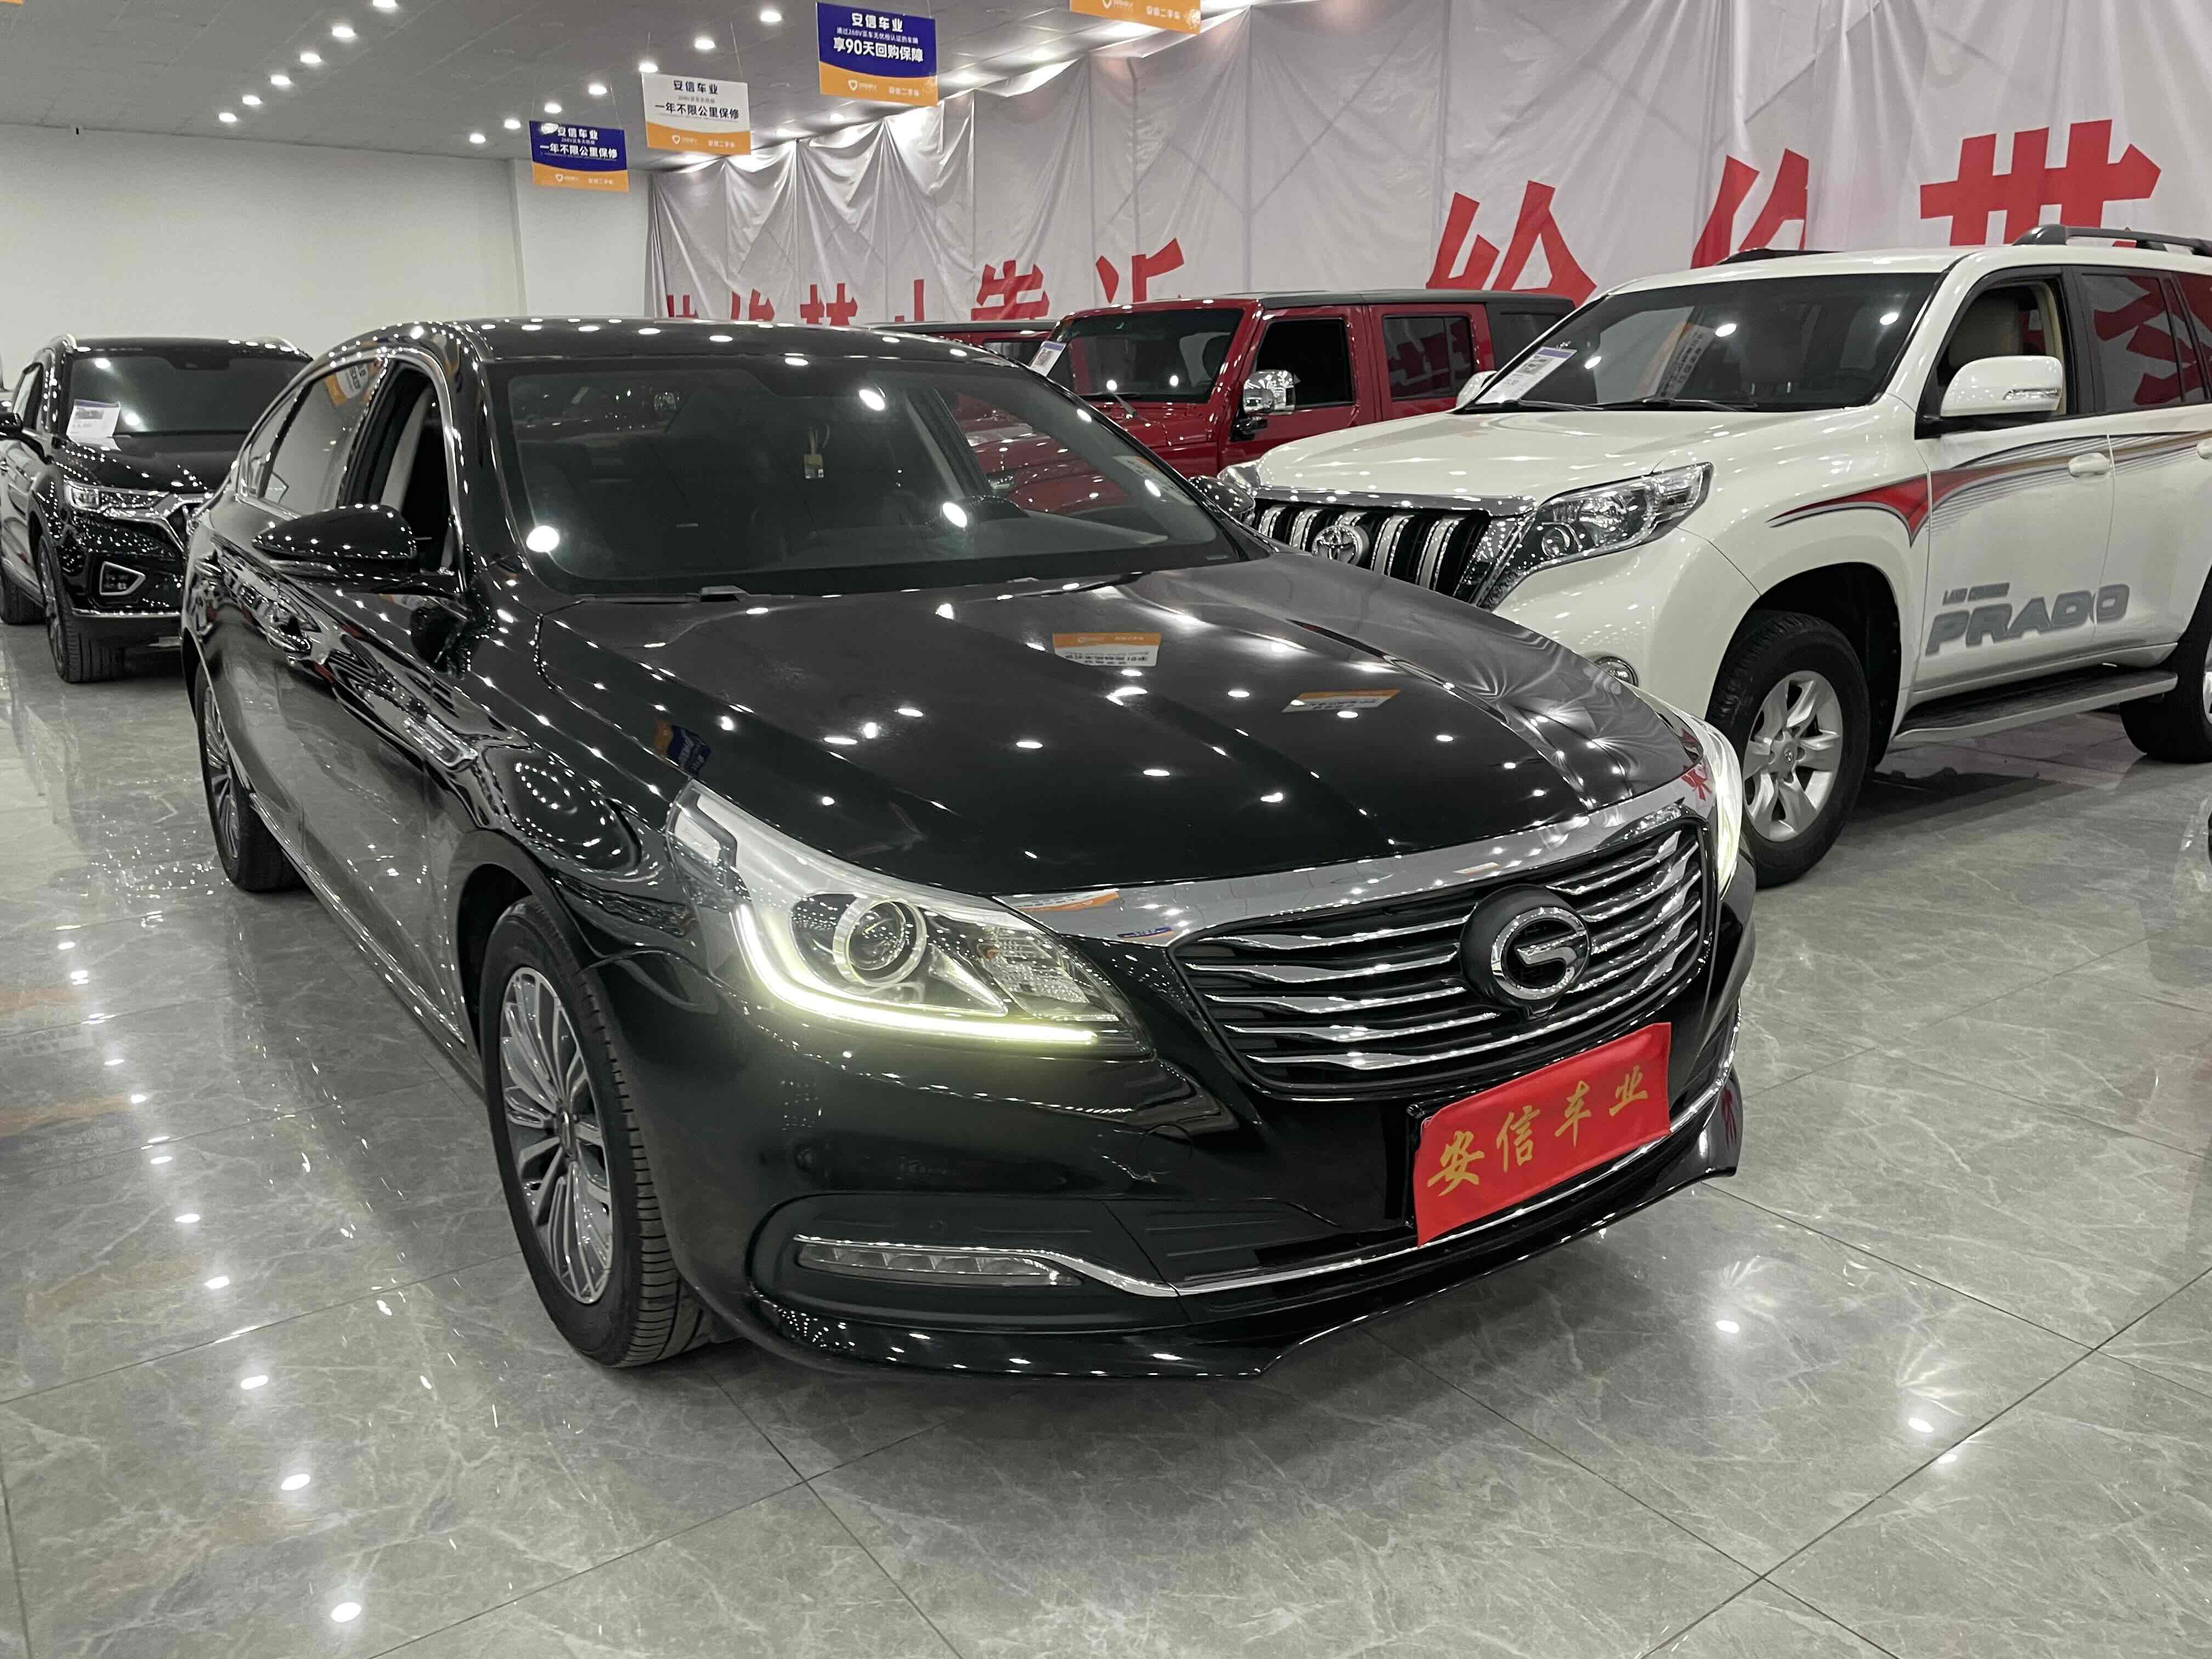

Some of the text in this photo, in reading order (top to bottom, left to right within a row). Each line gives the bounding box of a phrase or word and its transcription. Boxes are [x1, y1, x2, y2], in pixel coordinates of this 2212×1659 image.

[852, 13, 903, 32] 安信车业
[833, 37, 924, 63] 享90天回购保障
[673, 80, 718, 95] 安信车业
[654, 102, 740, 119] 一年不限公里保修
[558, 126, 599, 140] 安信车业
[540, 143, 618, 159] 一年不限公里保修
[1925, 583, 2130, 656] PRADO
[1427, 1065, 1649, 1198] 安信车业
